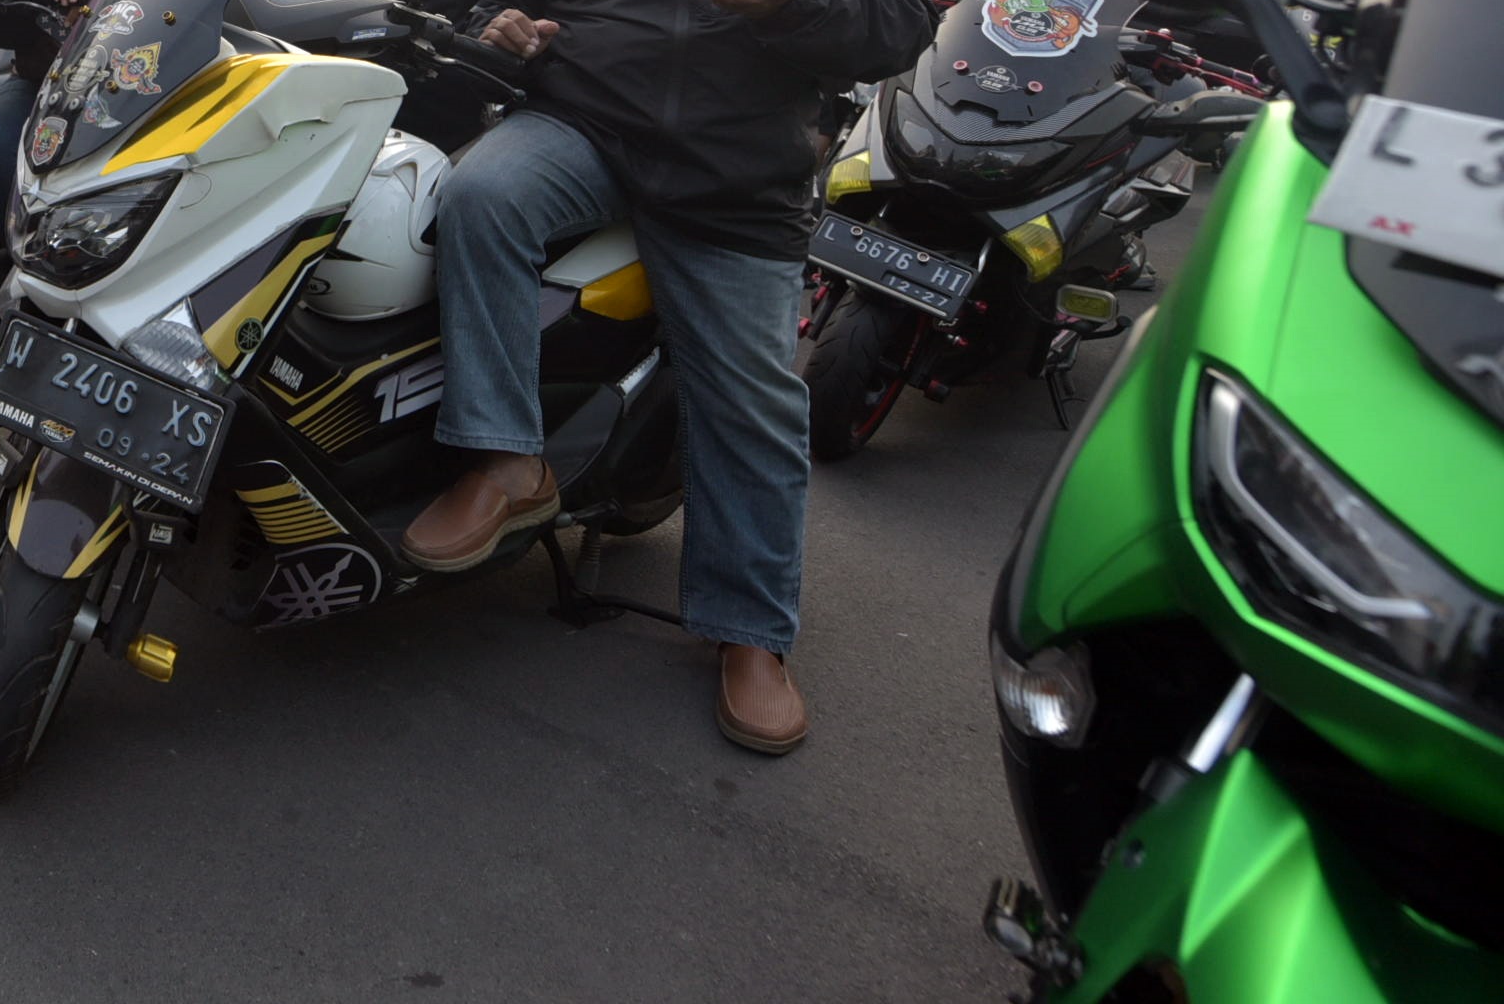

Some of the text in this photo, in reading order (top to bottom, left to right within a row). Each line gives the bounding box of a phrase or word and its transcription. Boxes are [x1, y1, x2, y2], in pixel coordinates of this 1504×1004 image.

[1371, 105, 1416, 167] L
[824, 222, 963, 292] L 6676 HI
[6, 330, 213, 447] W 2406 XS
[268, 355, 305, 392] YAMAHA
[82, 450, 137, 481] SEMAKIN
[137, 476, 151, 487] DI
[150, 482, 194, 505] DEPAN
